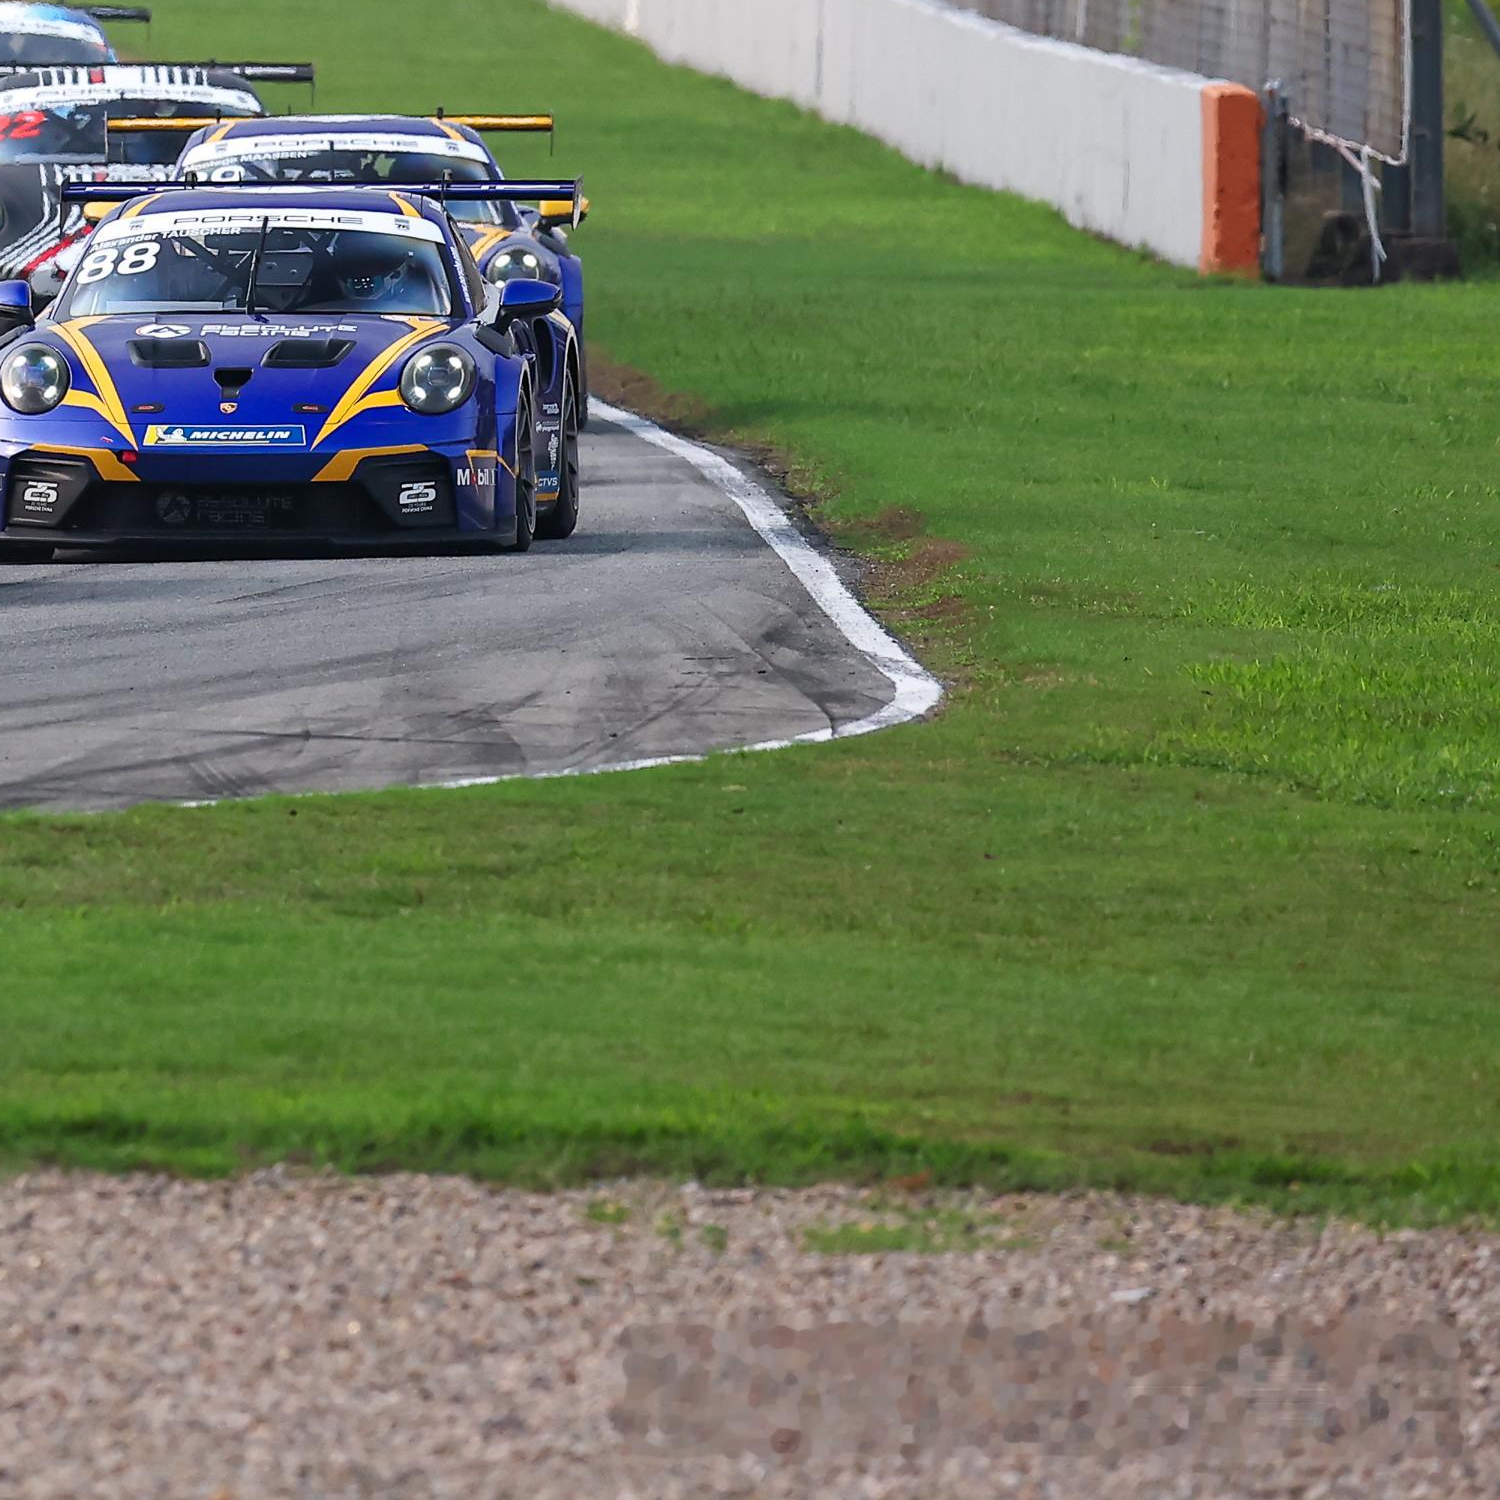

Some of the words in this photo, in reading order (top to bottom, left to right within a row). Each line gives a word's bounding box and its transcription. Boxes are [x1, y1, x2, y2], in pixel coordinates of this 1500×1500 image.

[174, 215, 363, 226] PORSCHE
[89, 232, 159, 253] Alexander
[159, 226, 242, 240] TAUSCHER
[75, 242, 162, 285] 88
[190, 429, 291, 441] MICHELIN
